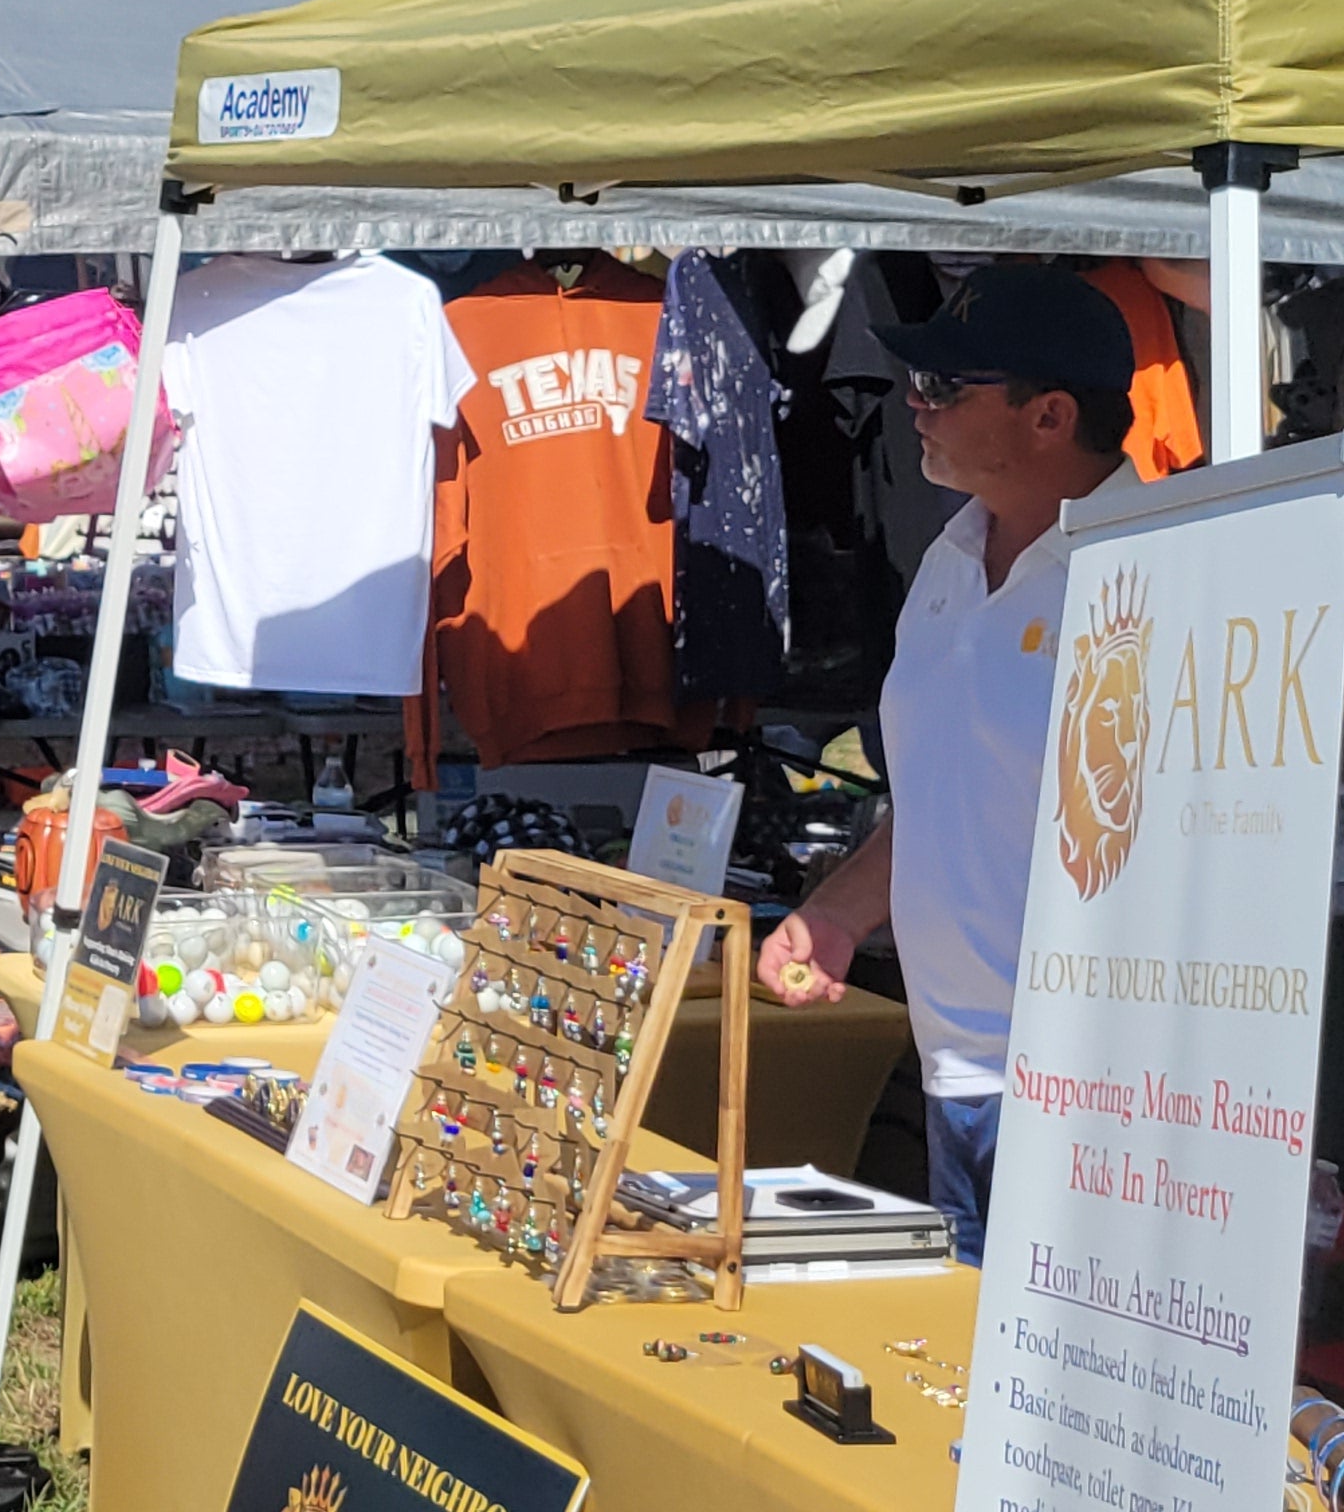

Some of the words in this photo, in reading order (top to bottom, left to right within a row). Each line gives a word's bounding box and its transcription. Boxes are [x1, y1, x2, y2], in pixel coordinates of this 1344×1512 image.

[219, 77, 311, 129] Academy
[487, 348, 643, 417] TEXAS
[1156, 604, 1331, 774] ARK
[1232, 800, 1285, 845] Family
[116, 892, 144, 926] ARK
[1028, 951, 1100, 1000] LOVE
[1106, 956, 1166, 1005] YOUR
[1174, 960, 1311, 1017] NEIGHBOR
[1012, 1053, 1136, 1127] Supporting
[1140, 1070, 1203, 1129] Moms
[1211, 1079, 1306, 1156] Raising
[1069, 1142, 1114, 1198] Kids
[1121, 1150, 1146, 1205] In
[1154, 1157, 1235, 1234] Poverty
[1029, 1242, 1081, 1294] How
[1087, 1256, 1121, 1310] You
[1125, 1270, 1164, 1320] Are
[1167, 1278, 1252, 1354] Helping
[1014, 1317, 1059, 1361] Food
[1062, 1337, 1128, 1383] purchased
[1132, 1364, 1147, 1389] to
[1149, 1358, 1176, 1402] feed
[1180, 1370, 1207, 1410] the
[1210, 1378, 1269, 1438] family.
[281, 1372, 341, 1433] LOVE
[335, 1404, 400, 1471] YOUR
[391, 1444, 508, 1512] NEIGHB
[1004, 1439, 1084, 1492] toothpaste,
[1087, 1467, 1125, 1511] toilet
[1009, 1376, 1056, 1423] Basic
[1058, 1394, 1091, 1435] items
[1093, 1413, 1127, 1450] such
[1130, 1429, 1145, 1455] as
[1148, 1426, 1225, 1493] deodorant,
